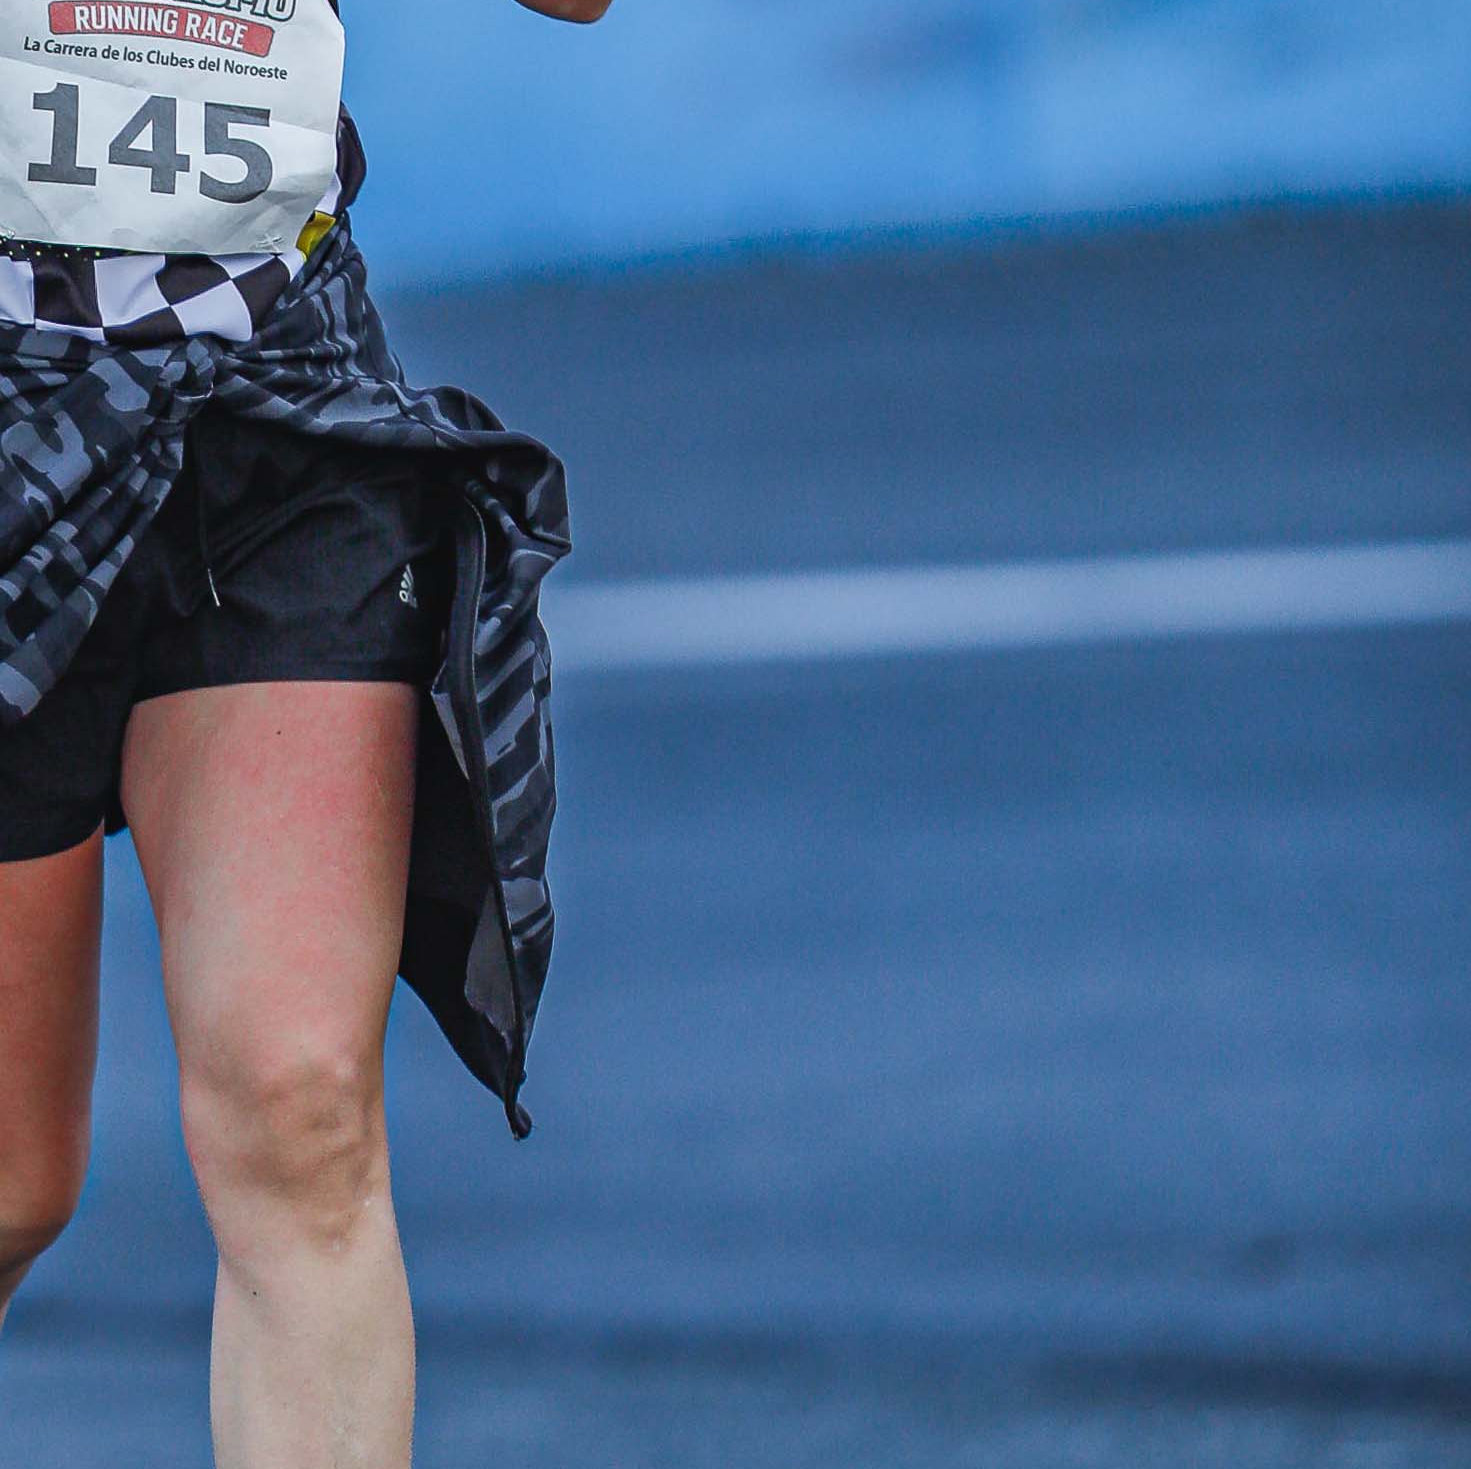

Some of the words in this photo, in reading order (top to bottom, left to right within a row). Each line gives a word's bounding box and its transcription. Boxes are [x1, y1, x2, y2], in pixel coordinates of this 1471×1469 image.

[73, 5, 179, 35] RUNNING
[184, 12, 249, 50] RACE
[23, 36, 41, 52] La
[43, 39, 98, 58] Carrera
[101, 45, 120, 61] de
[123, 46, 144, 63] los
[146, 50, 195, 69] Clubes
[198, 56, 221, 72] del
[224, 59, 288, 80] Noroeste
[27, 82, 274, 205] 145
